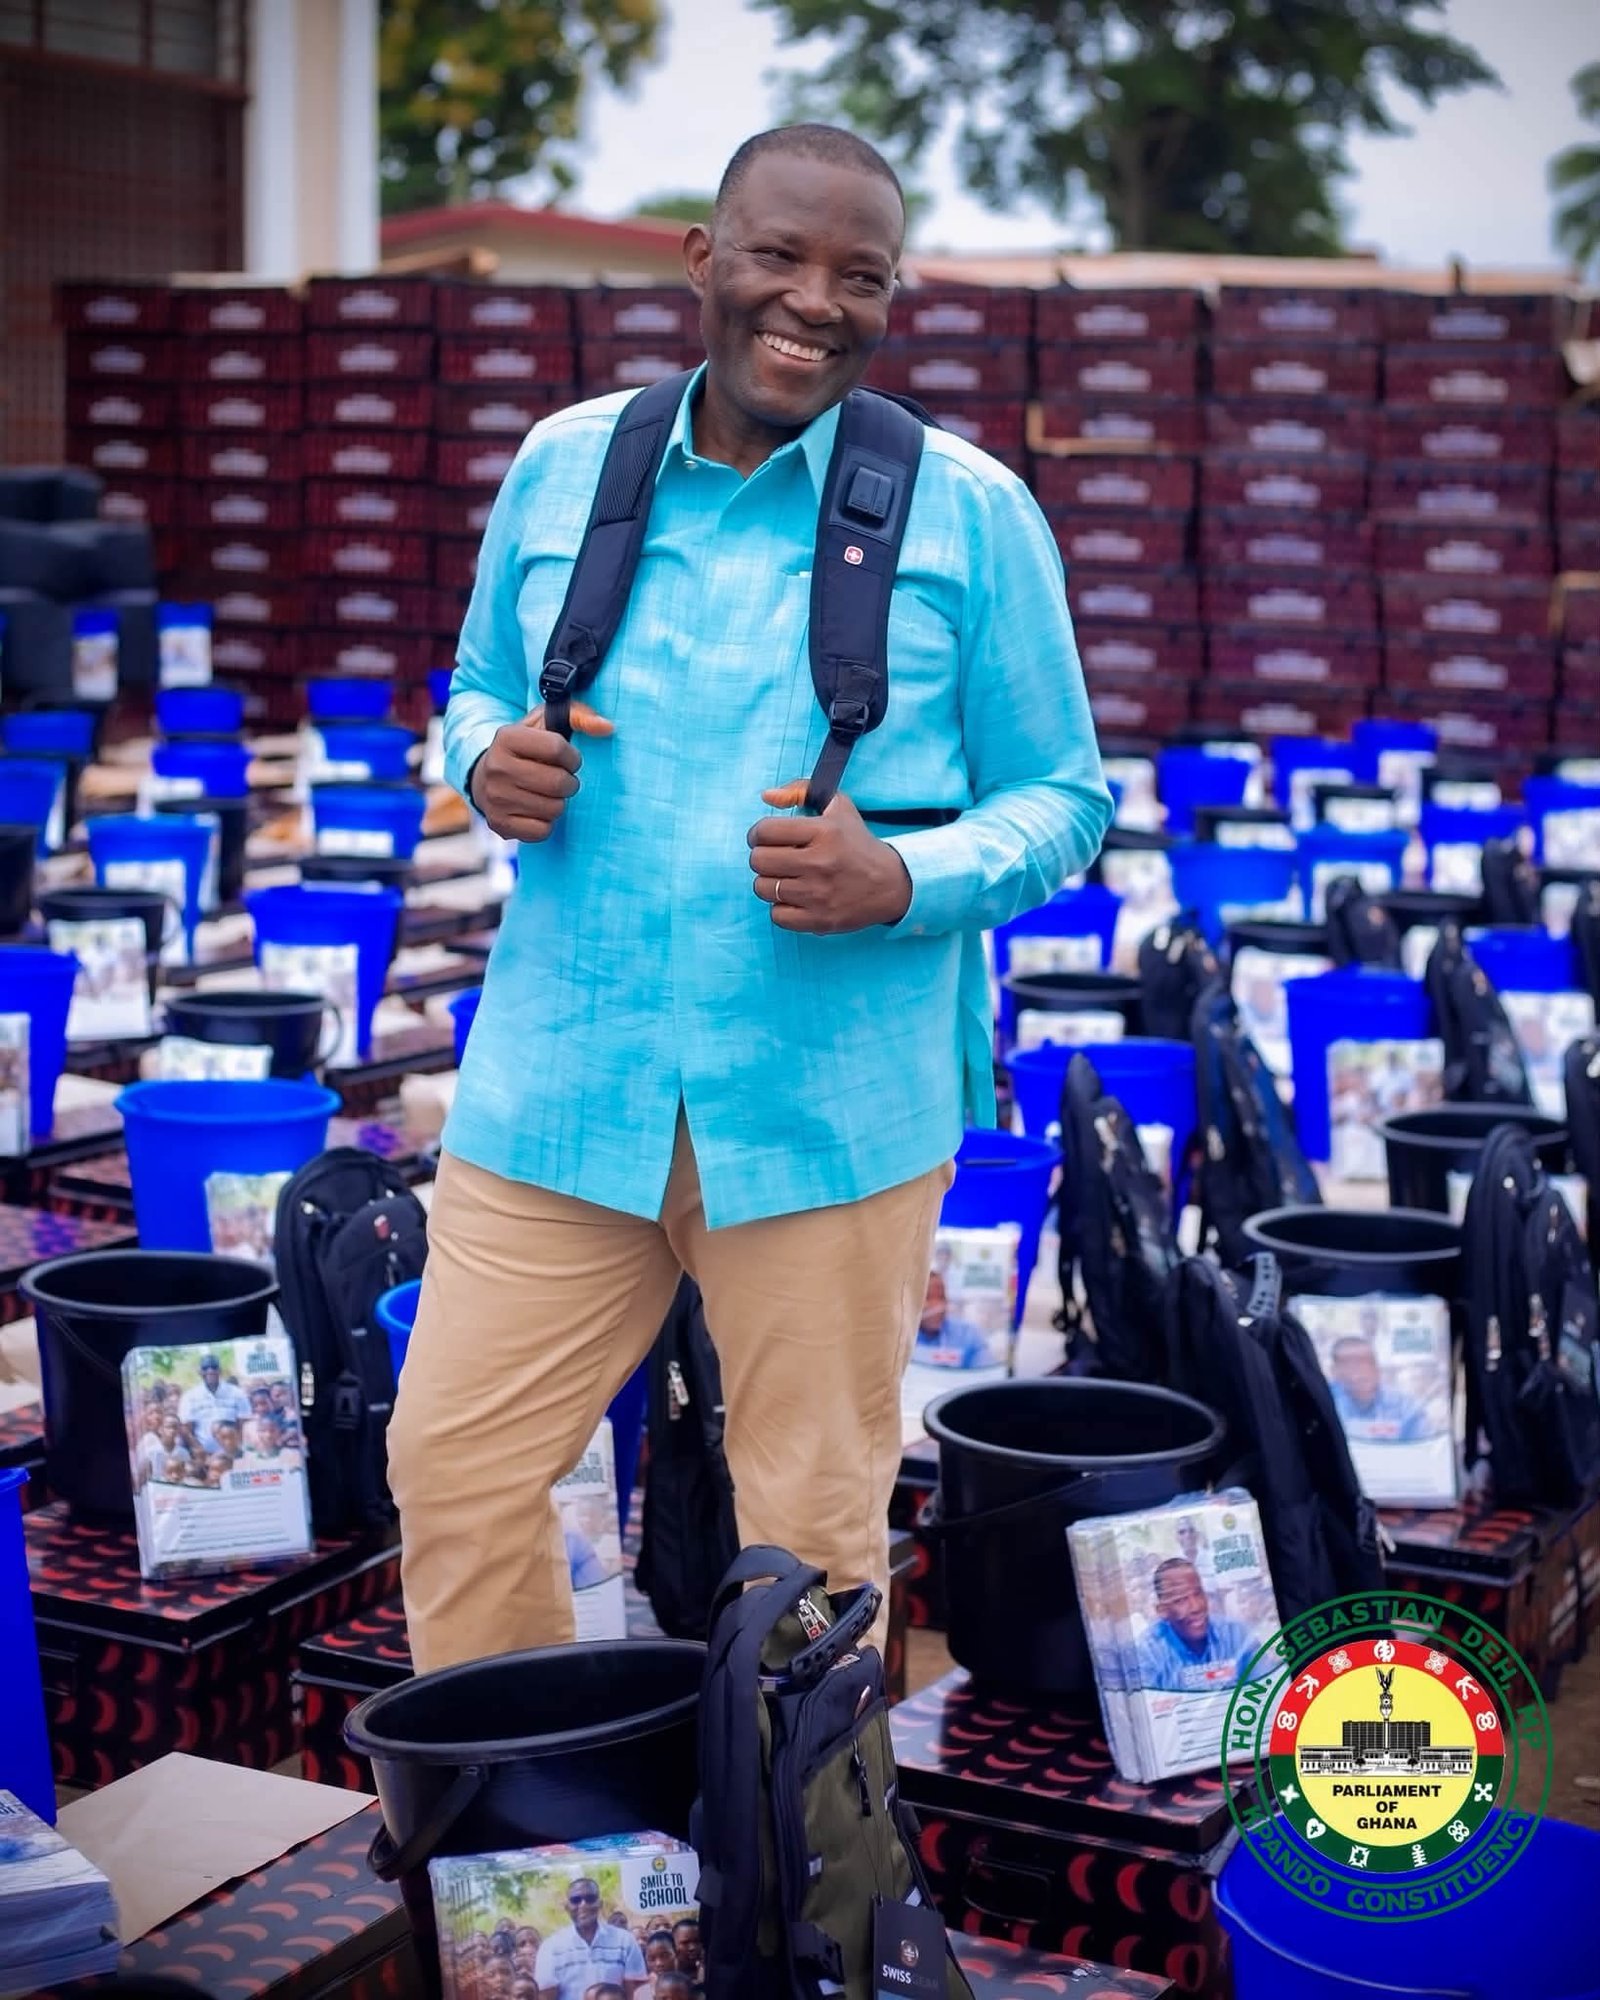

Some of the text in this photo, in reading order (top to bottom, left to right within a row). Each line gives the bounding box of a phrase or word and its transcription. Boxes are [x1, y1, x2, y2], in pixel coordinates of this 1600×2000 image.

[640, 1873, 684, 1890] SMILE TO
[639, 1886, 690, 1910] SCHOOL
